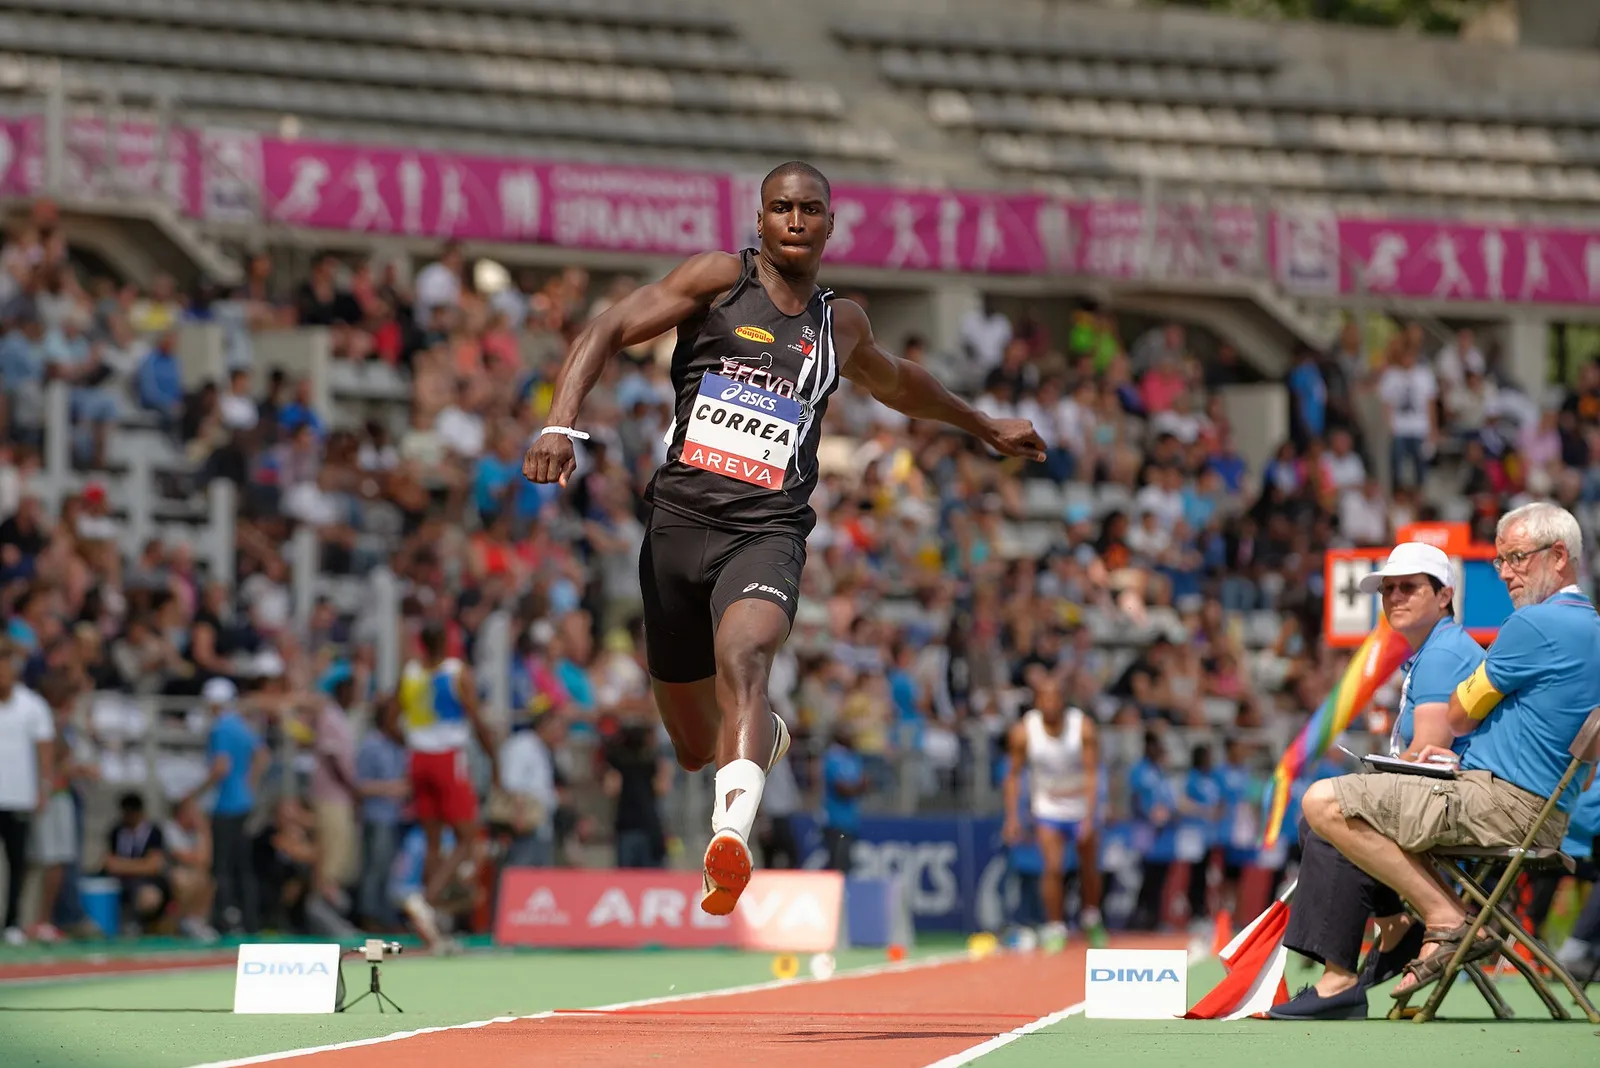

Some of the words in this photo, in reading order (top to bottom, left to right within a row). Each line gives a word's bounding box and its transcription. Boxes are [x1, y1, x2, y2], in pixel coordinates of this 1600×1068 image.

[738, 390, 776, 412] asics
[695, 403, 790, 446] CORREA
[763, 449, 771, 461] 2
[690, 448, 773, 485] AREVA
[758, 584, 788, 601] asics
[243, 961, 329, 975] DIMA
[1090, 968, 1180, 983] DIMA
